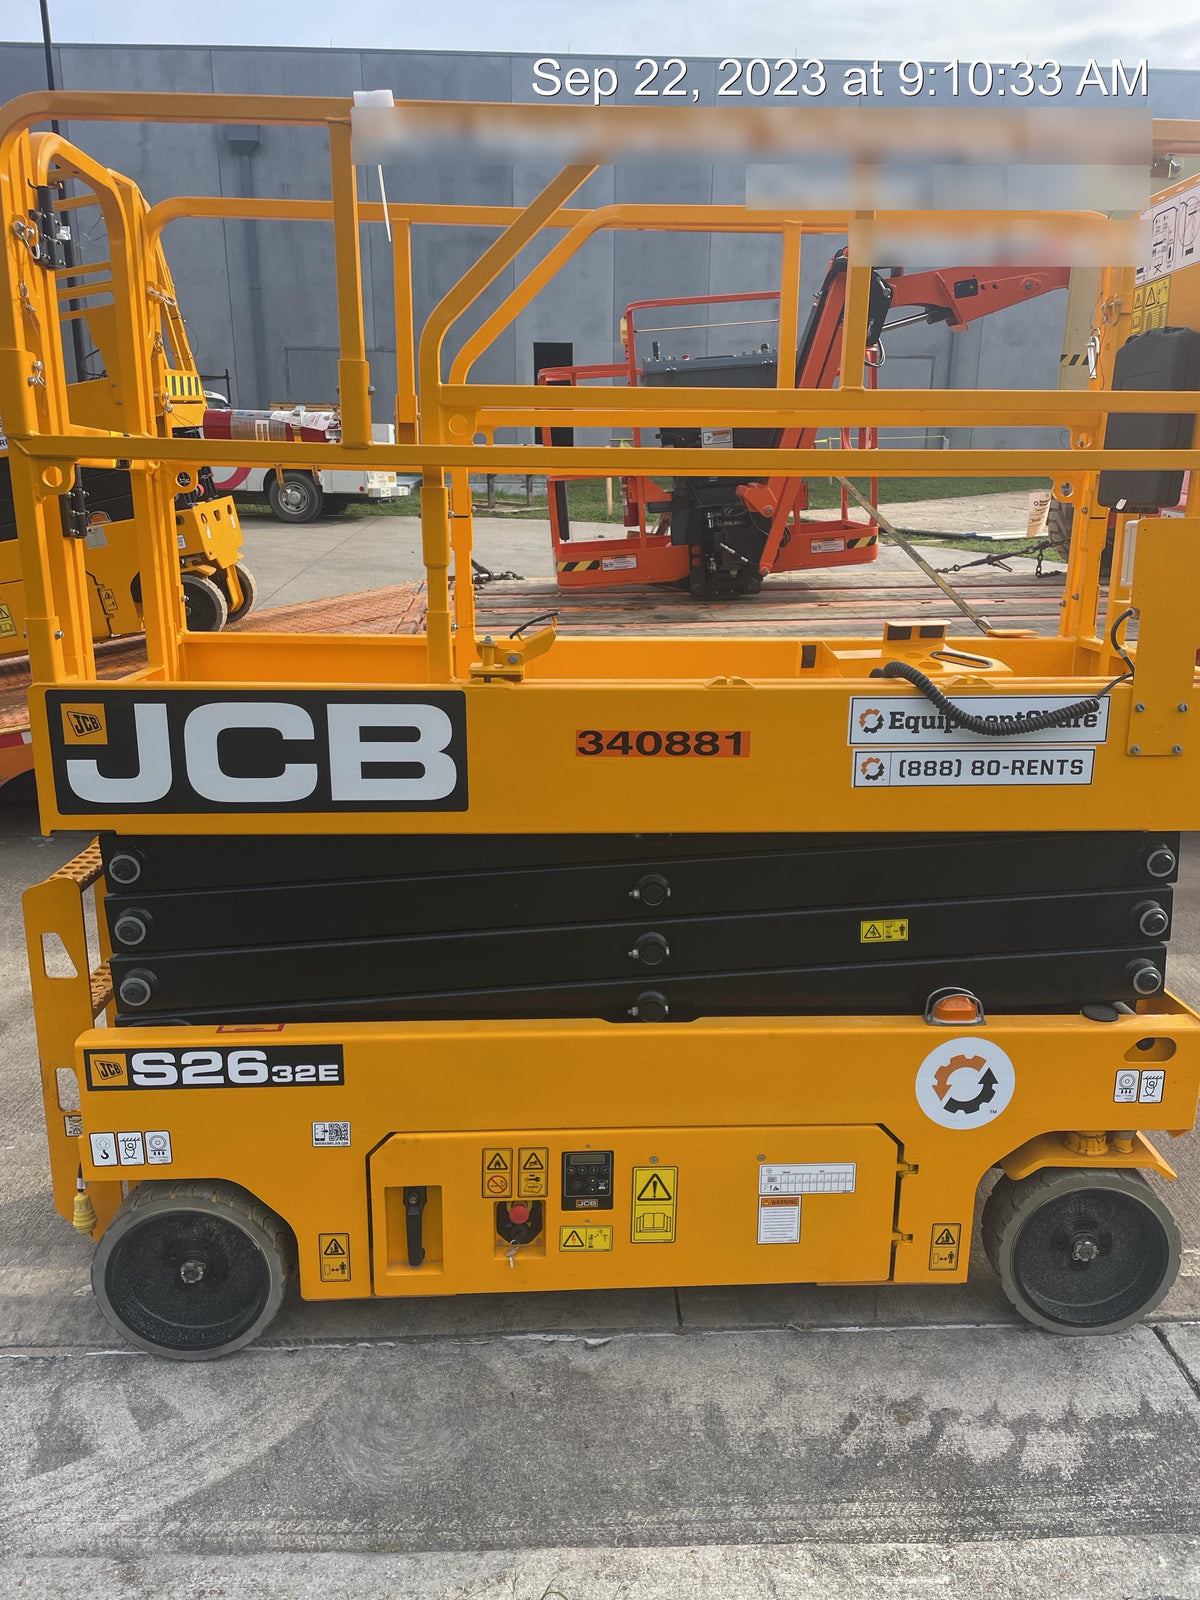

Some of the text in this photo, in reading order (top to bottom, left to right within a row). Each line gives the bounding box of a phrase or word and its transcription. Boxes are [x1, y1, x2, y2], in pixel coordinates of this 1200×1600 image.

[72, 711, 101, 733] JCB
[888, 711, 1098, 734] EquipentSare
[66, 701, 458, 804] JCB
[577, 730, 742, 756] 340881
[899, 759, 1084, 778] (888) 80-RENTS
[99, 1062, 121, 1079] JCB
[771, 1198, 798, 1206] WARNING
